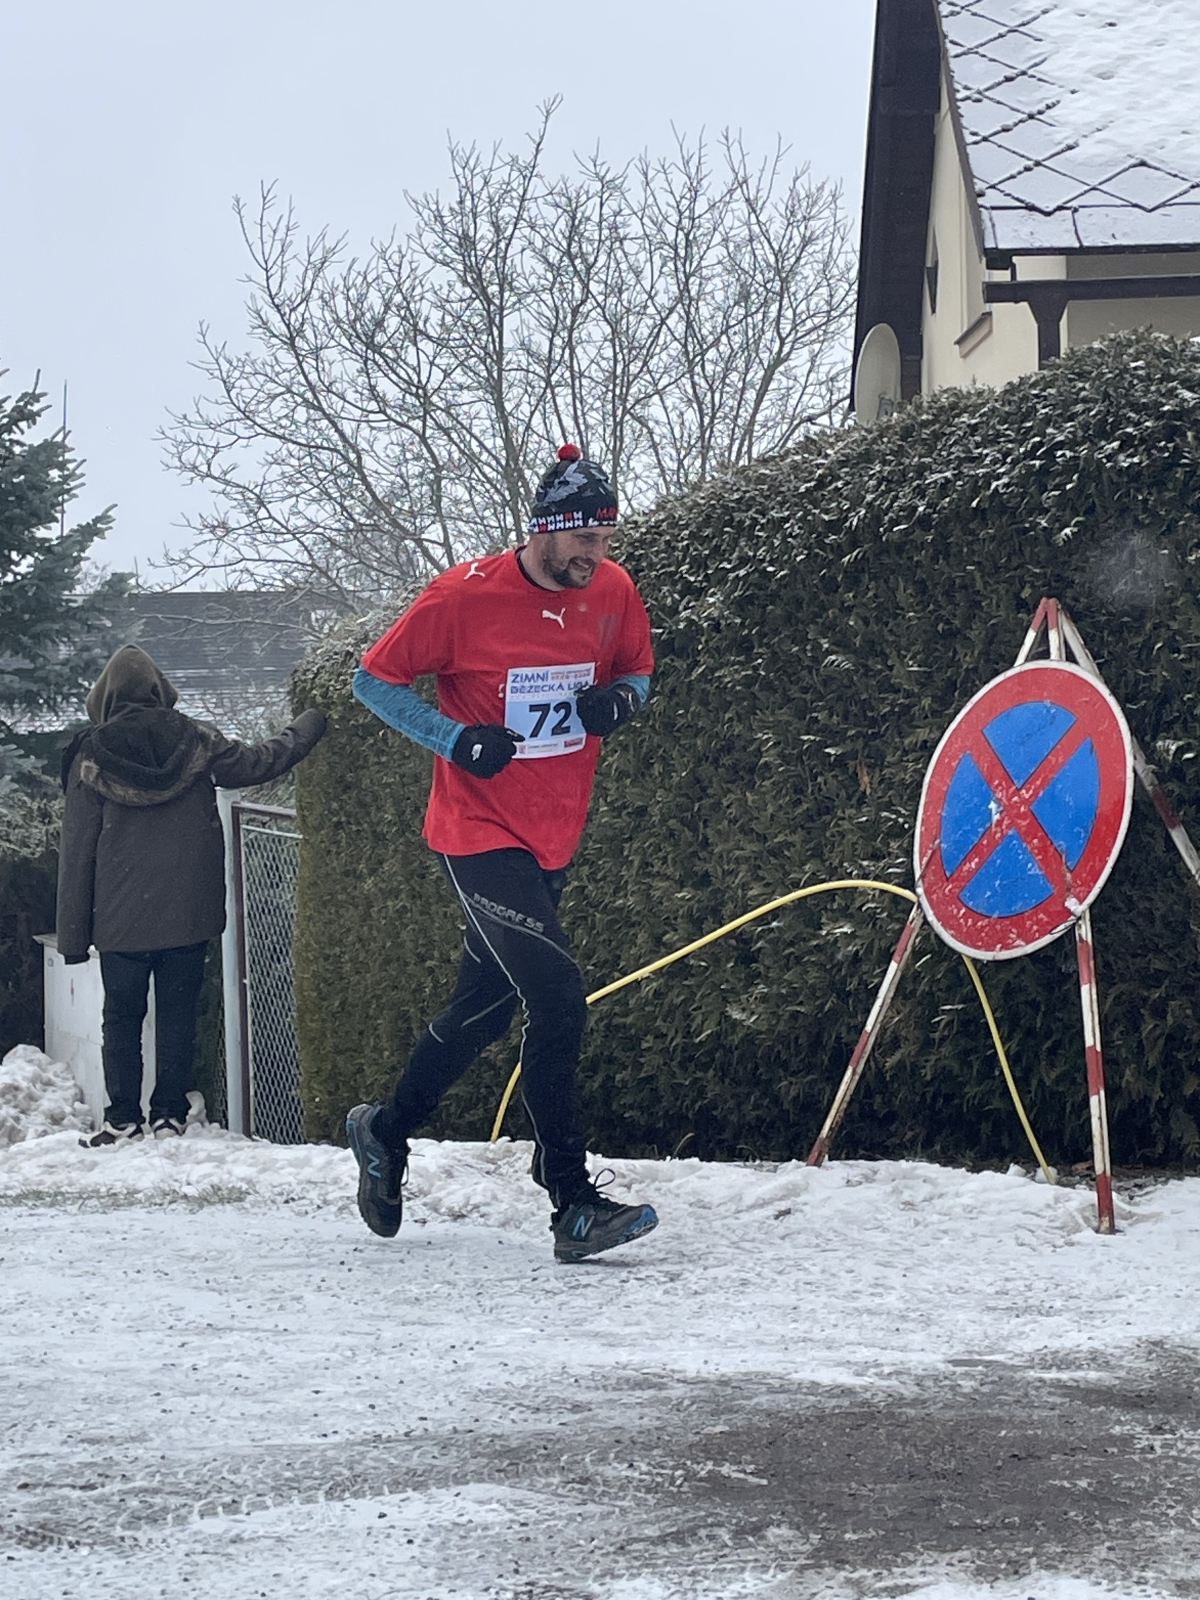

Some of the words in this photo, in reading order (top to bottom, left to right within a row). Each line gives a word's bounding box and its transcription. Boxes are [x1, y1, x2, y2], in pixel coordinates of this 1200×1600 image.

[511, 670, 549, 684] ZIMNÍ
[529, 701, 572, 738] 72
[473, 893, 544, 933] PROGRESS
[572, 1215, 595, 1237] N
